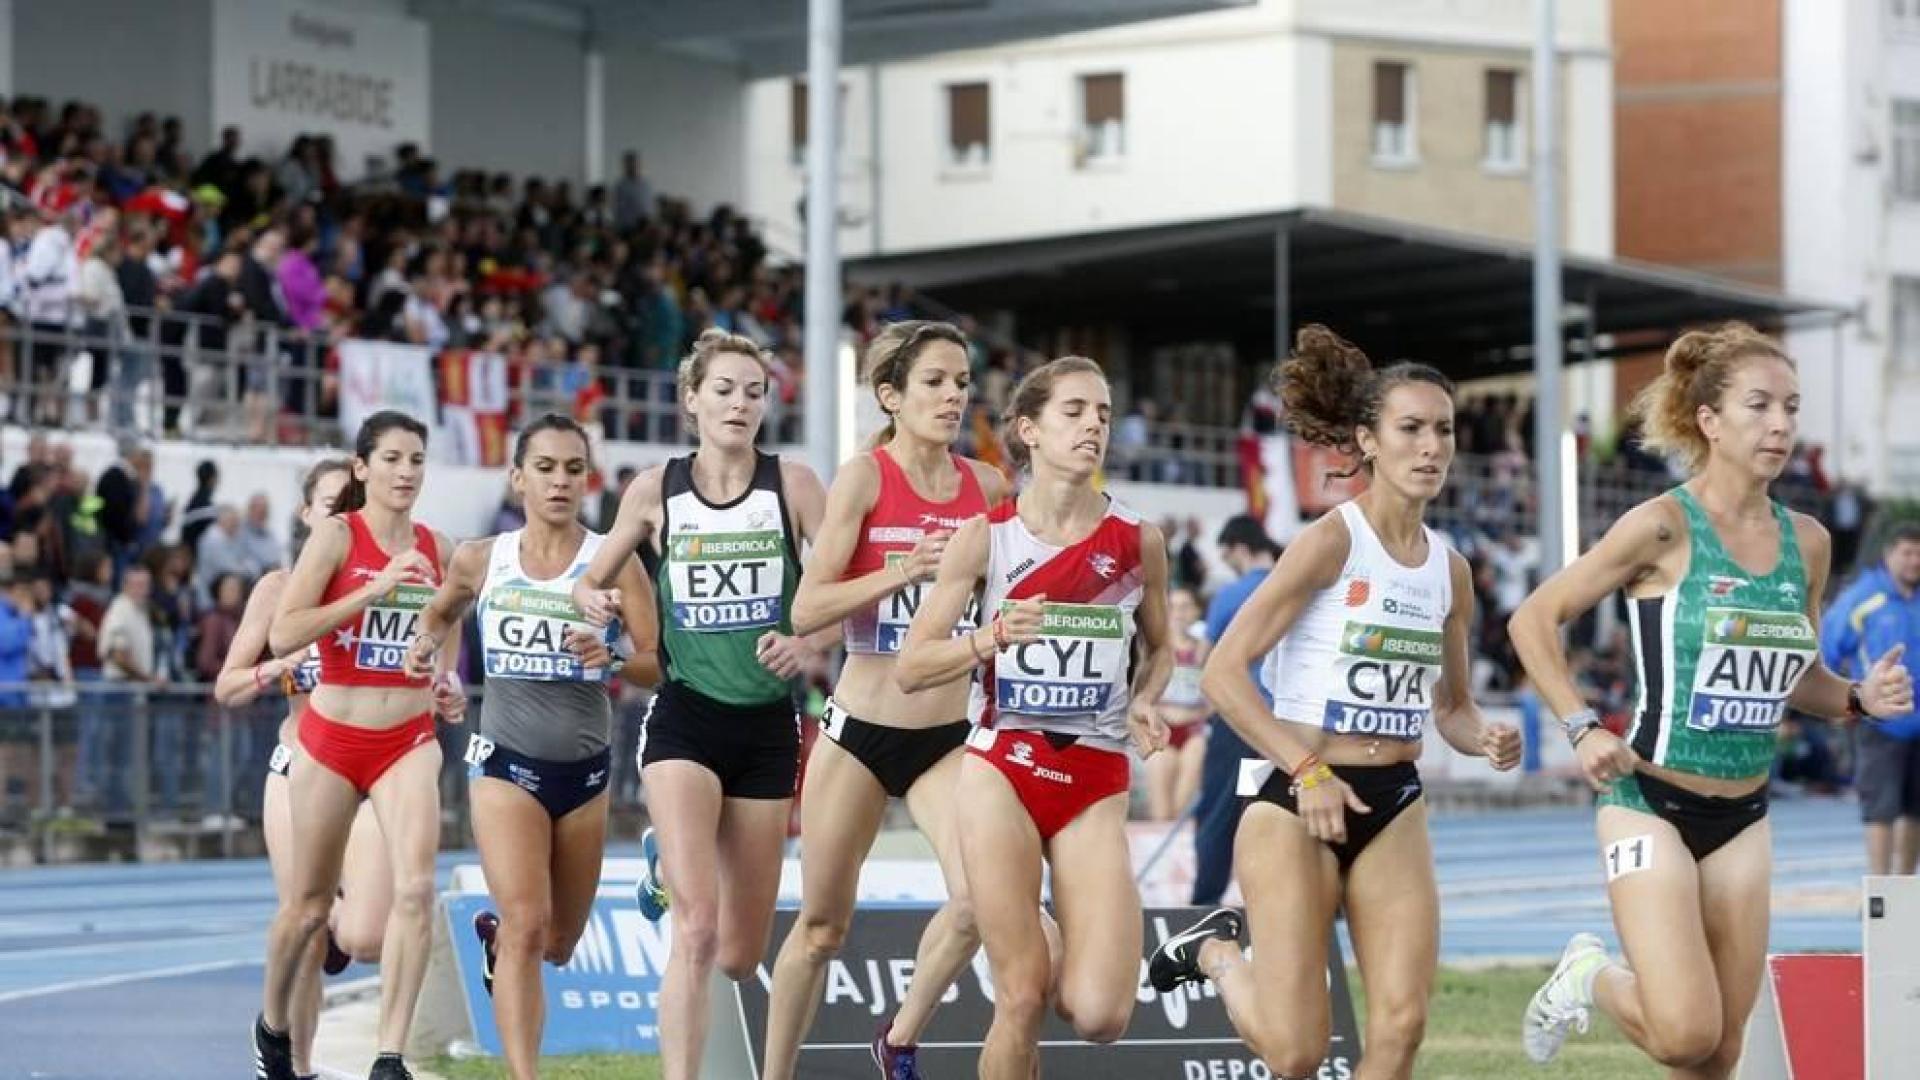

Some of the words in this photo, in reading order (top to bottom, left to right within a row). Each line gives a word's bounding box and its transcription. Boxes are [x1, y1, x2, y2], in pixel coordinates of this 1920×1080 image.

[701, 539, 776, 554] IBERDROLA
[687, 561, 767, 598] EXT
[367, 610, 420, 641] MA
[682, 600, 771, 628] Joma
[1043, 613, 1118, 631] BERDROLA
[367, 647, 408, 667] Jo
[1016, 639, 1103, 679] CYL
[1382, 637, 1442, 656] IBERDROL
[494, 652, 573, 676] Joma
[1705, 648, 1806, 693] AND
[1008, 682, 1099, 708] Joma
[1347, 660, 1427, 704] CVA
[1335, 706, 1424, 736] Joma
[1609, 838, 1643, 875] 11
[756, 959, 959, 1015] AJE
[1184, 1056, 1351, 1080] DEPOES
